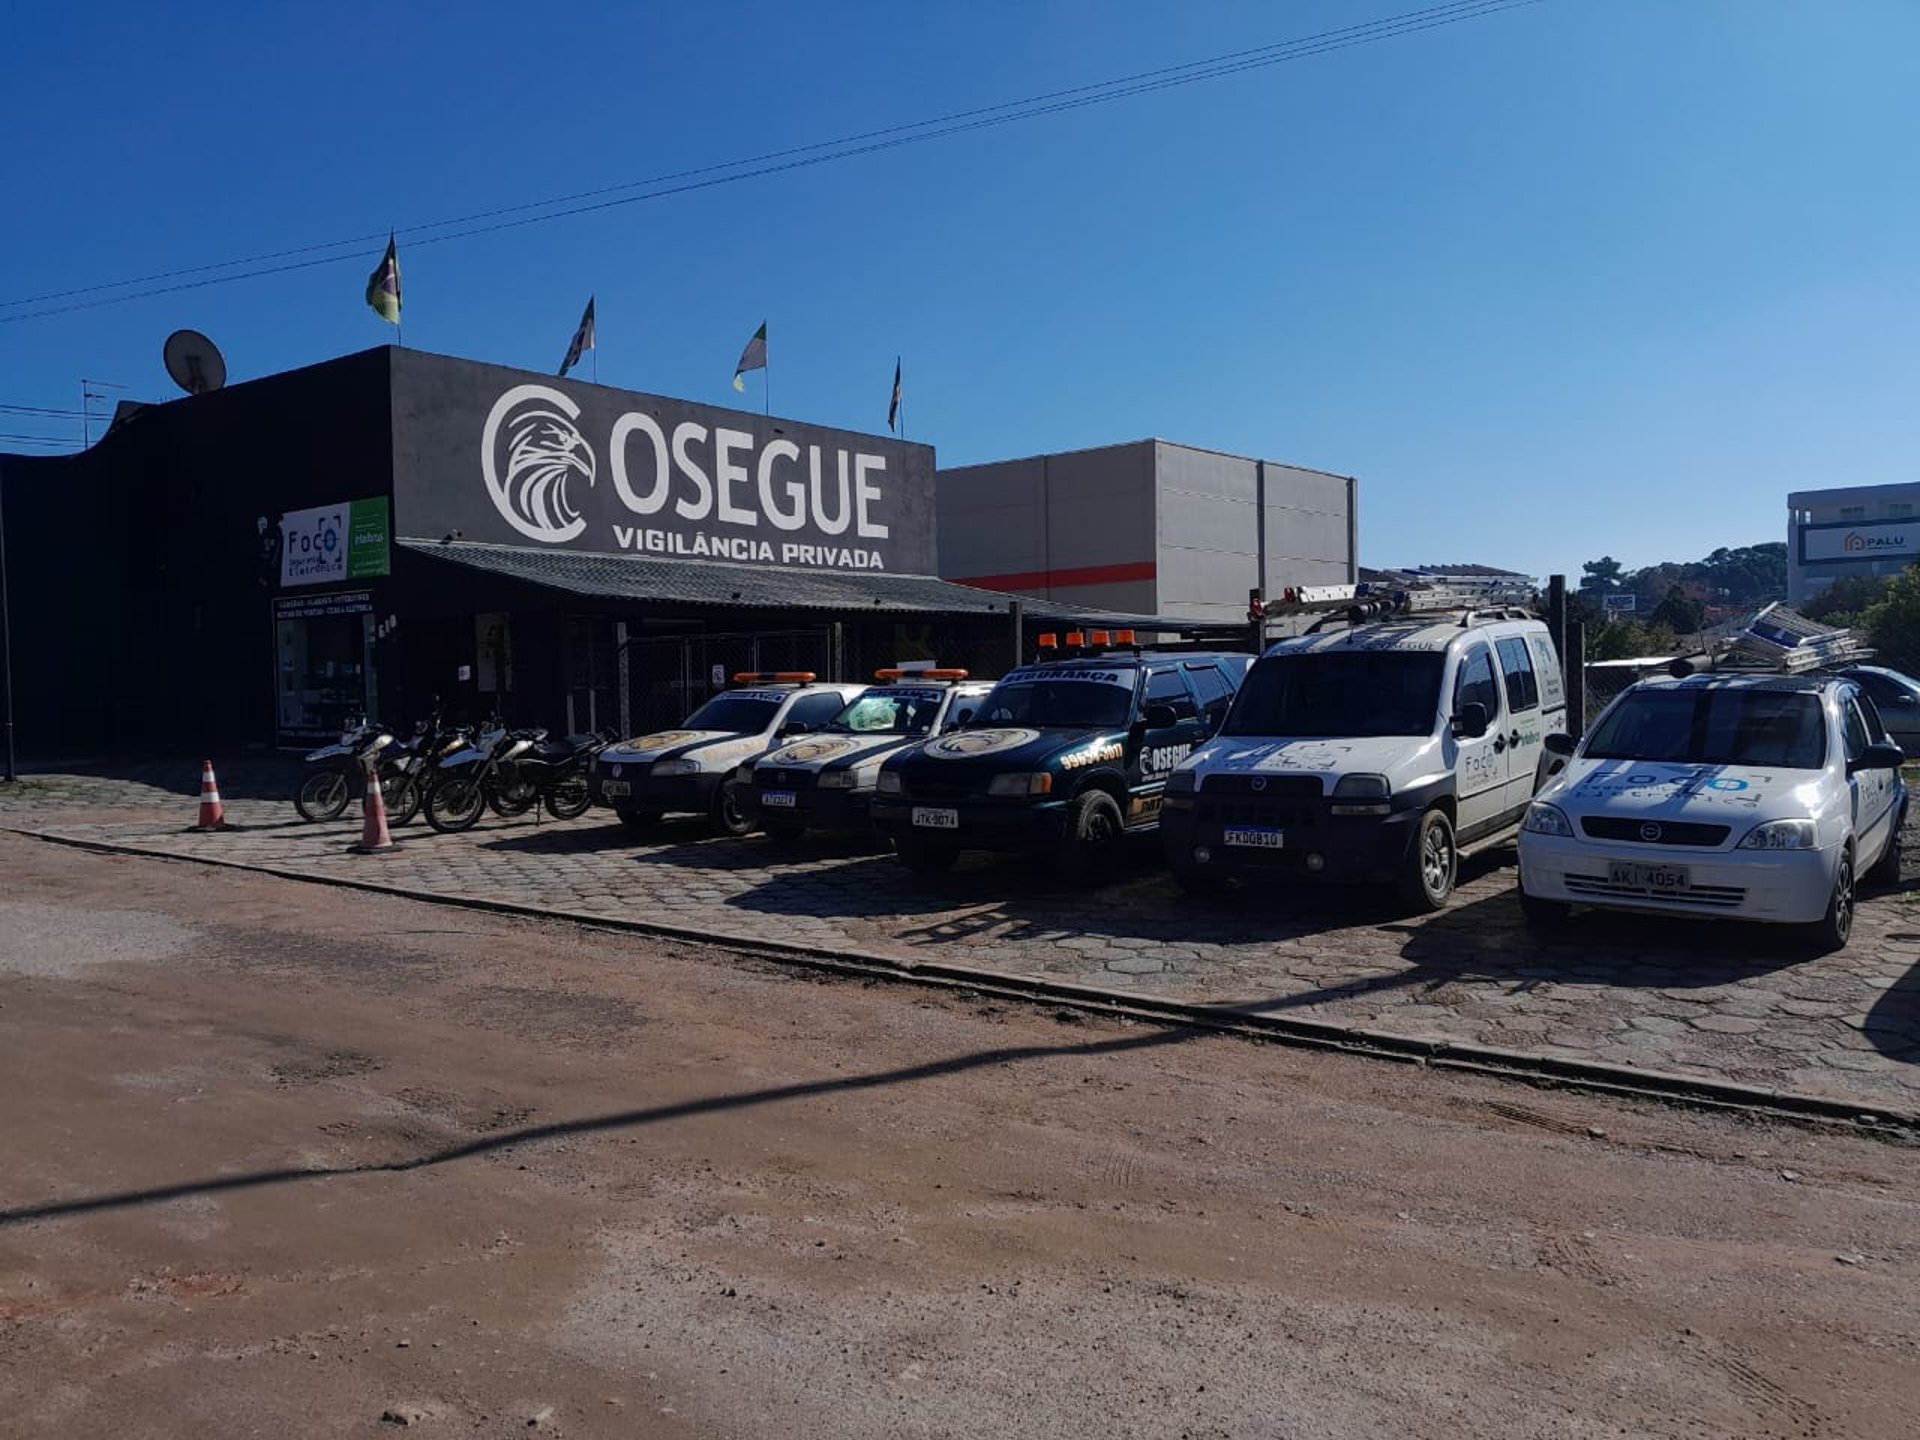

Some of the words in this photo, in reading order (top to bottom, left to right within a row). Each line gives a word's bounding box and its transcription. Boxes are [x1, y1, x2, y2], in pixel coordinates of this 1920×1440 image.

[612, 524, 775, 562] VIGILÂNCIA
[781, 543, 884, 569] PRIVADA
[1867, 536, 1904, 546] PALU
